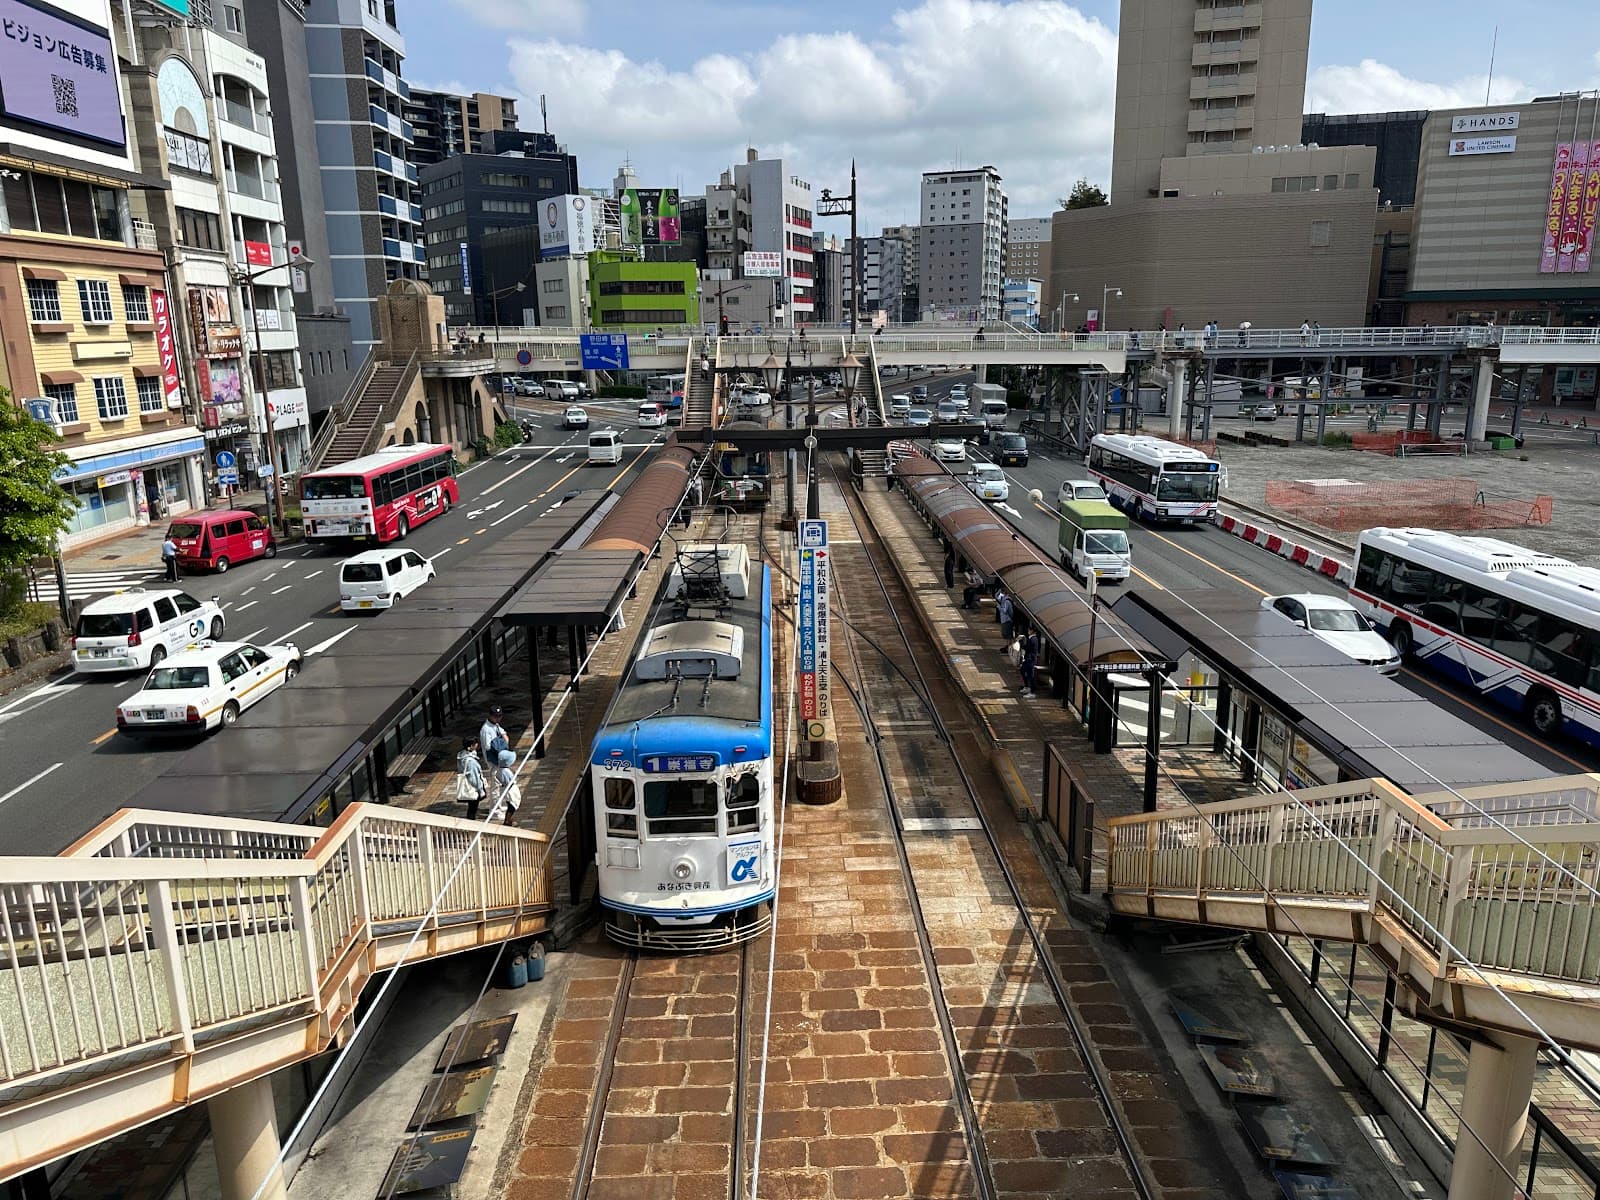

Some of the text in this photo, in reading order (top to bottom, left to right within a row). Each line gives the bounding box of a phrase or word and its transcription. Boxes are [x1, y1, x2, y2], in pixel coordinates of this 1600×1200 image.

[2, 17, 108, 74] ビジョン広告募集
[1470, 116, 1515, 128] HANDS
[1548, 172, 1566, 237] つかえる。
[155, 296, 173, 370] カラオケ
[276, 403, 296, 416] PLAGE
[816, 560, 828, 717] 平和公園・原爆資料館・浦上天主堂 のりば
[603, 758, 632, 772] 372
[647, 756, 660, 771] 1
[656, 881, 711, 891] あなぶき興産
